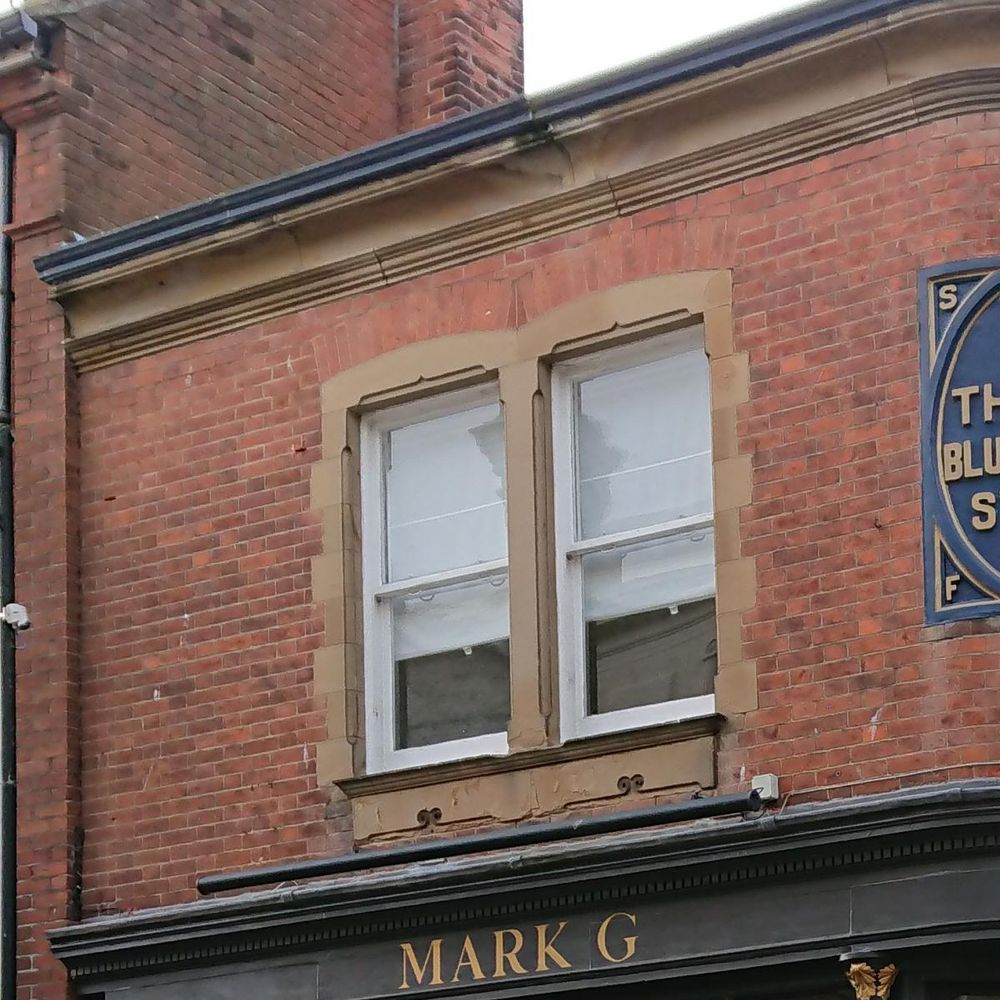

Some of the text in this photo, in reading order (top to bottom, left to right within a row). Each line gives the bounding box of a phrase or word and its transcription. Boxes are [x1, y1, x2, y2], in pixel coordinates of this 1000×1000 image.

[938, 283, 958, 311] S
[945, 574, 960, 601] F
[398, 912, 639, 990] MARK G
